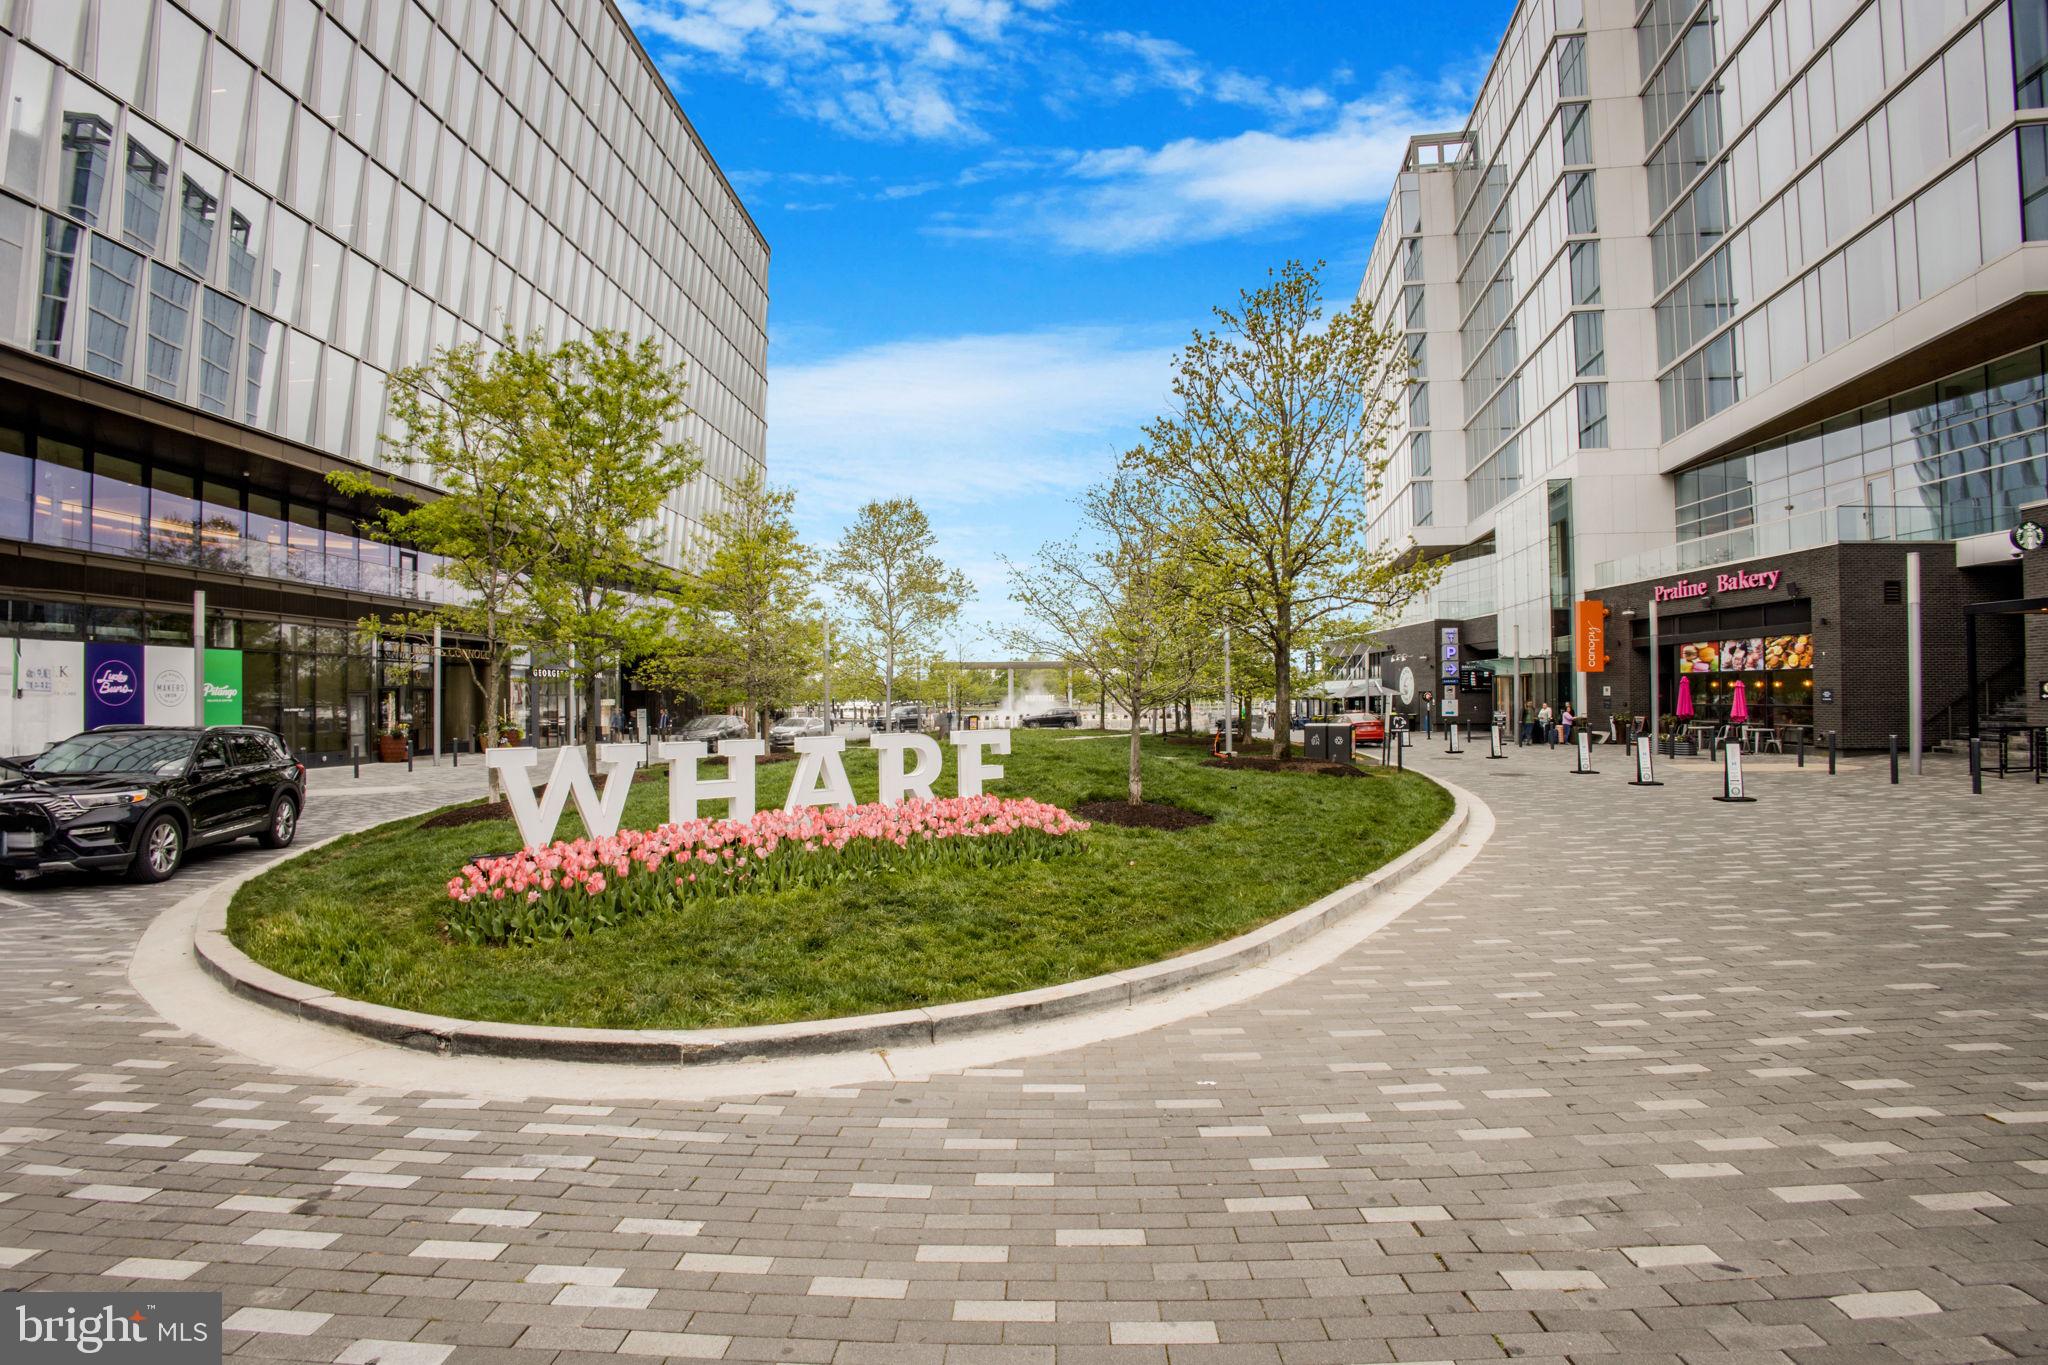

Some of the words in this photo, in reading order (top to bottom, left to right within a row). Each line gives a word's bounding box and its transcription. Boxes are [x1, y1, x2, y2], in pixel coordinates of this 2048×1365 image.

[1655, 580, 1708, 601] Praline
[1716, 569, 1780, 593] Bakery
[1446, 646, 1457, 660] P
[1588, 620, 1601, 667] canopy
[203, 682, 238, 699] Pitango
[485, 729, 1012, 856] WHARF
